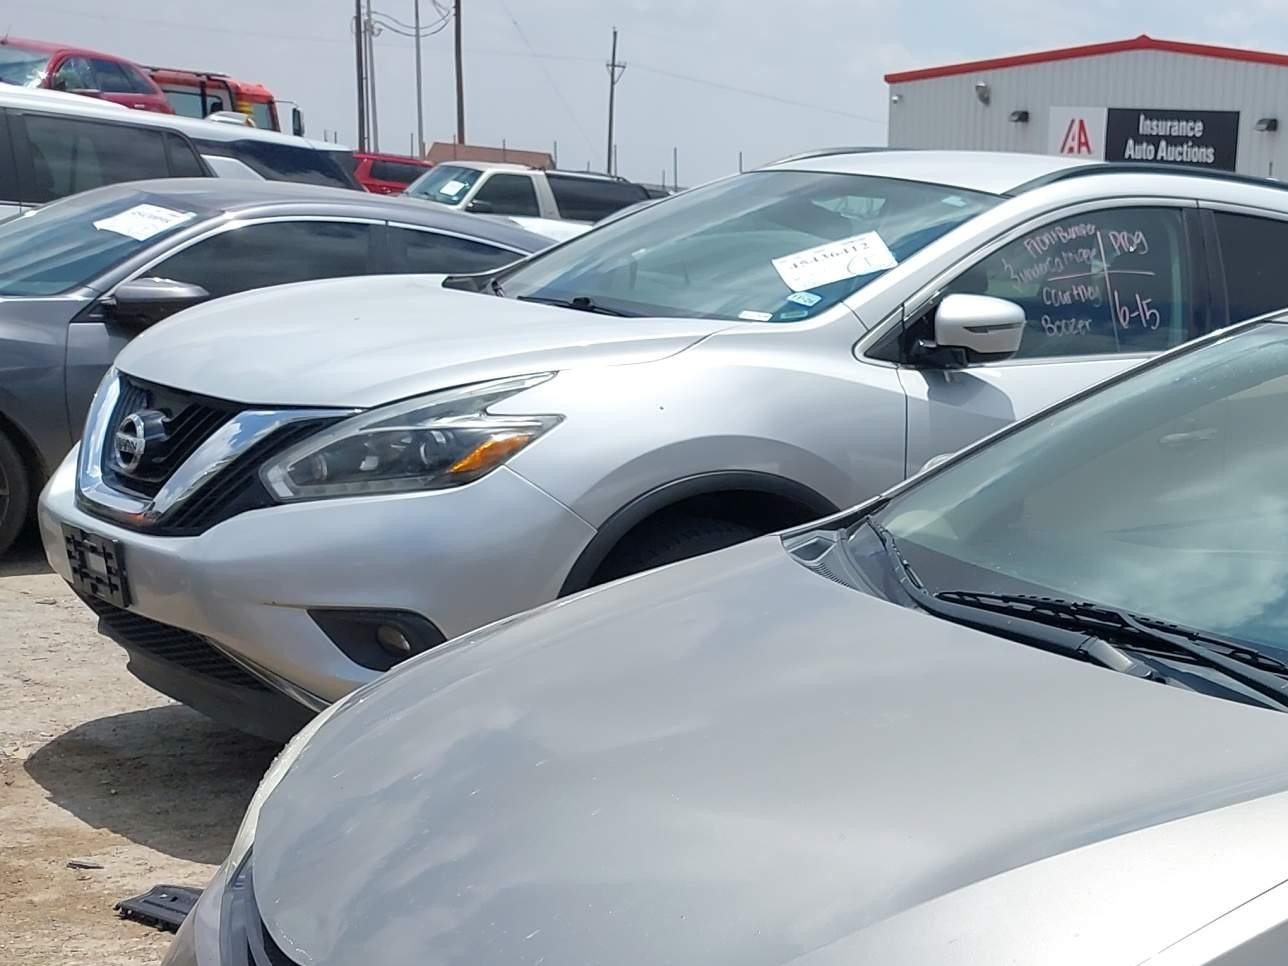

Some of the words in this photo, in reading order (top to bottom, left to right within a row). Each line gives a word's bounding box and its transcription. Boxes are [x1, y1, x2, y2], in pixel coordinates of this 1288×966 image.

[1139, 113, 1203, 136] Insurance
[1124, 138, 1155, 161] Auto
[1157, 139, 1215, 164] Auctions
[1113, 290, 1160, 330] 6-15
